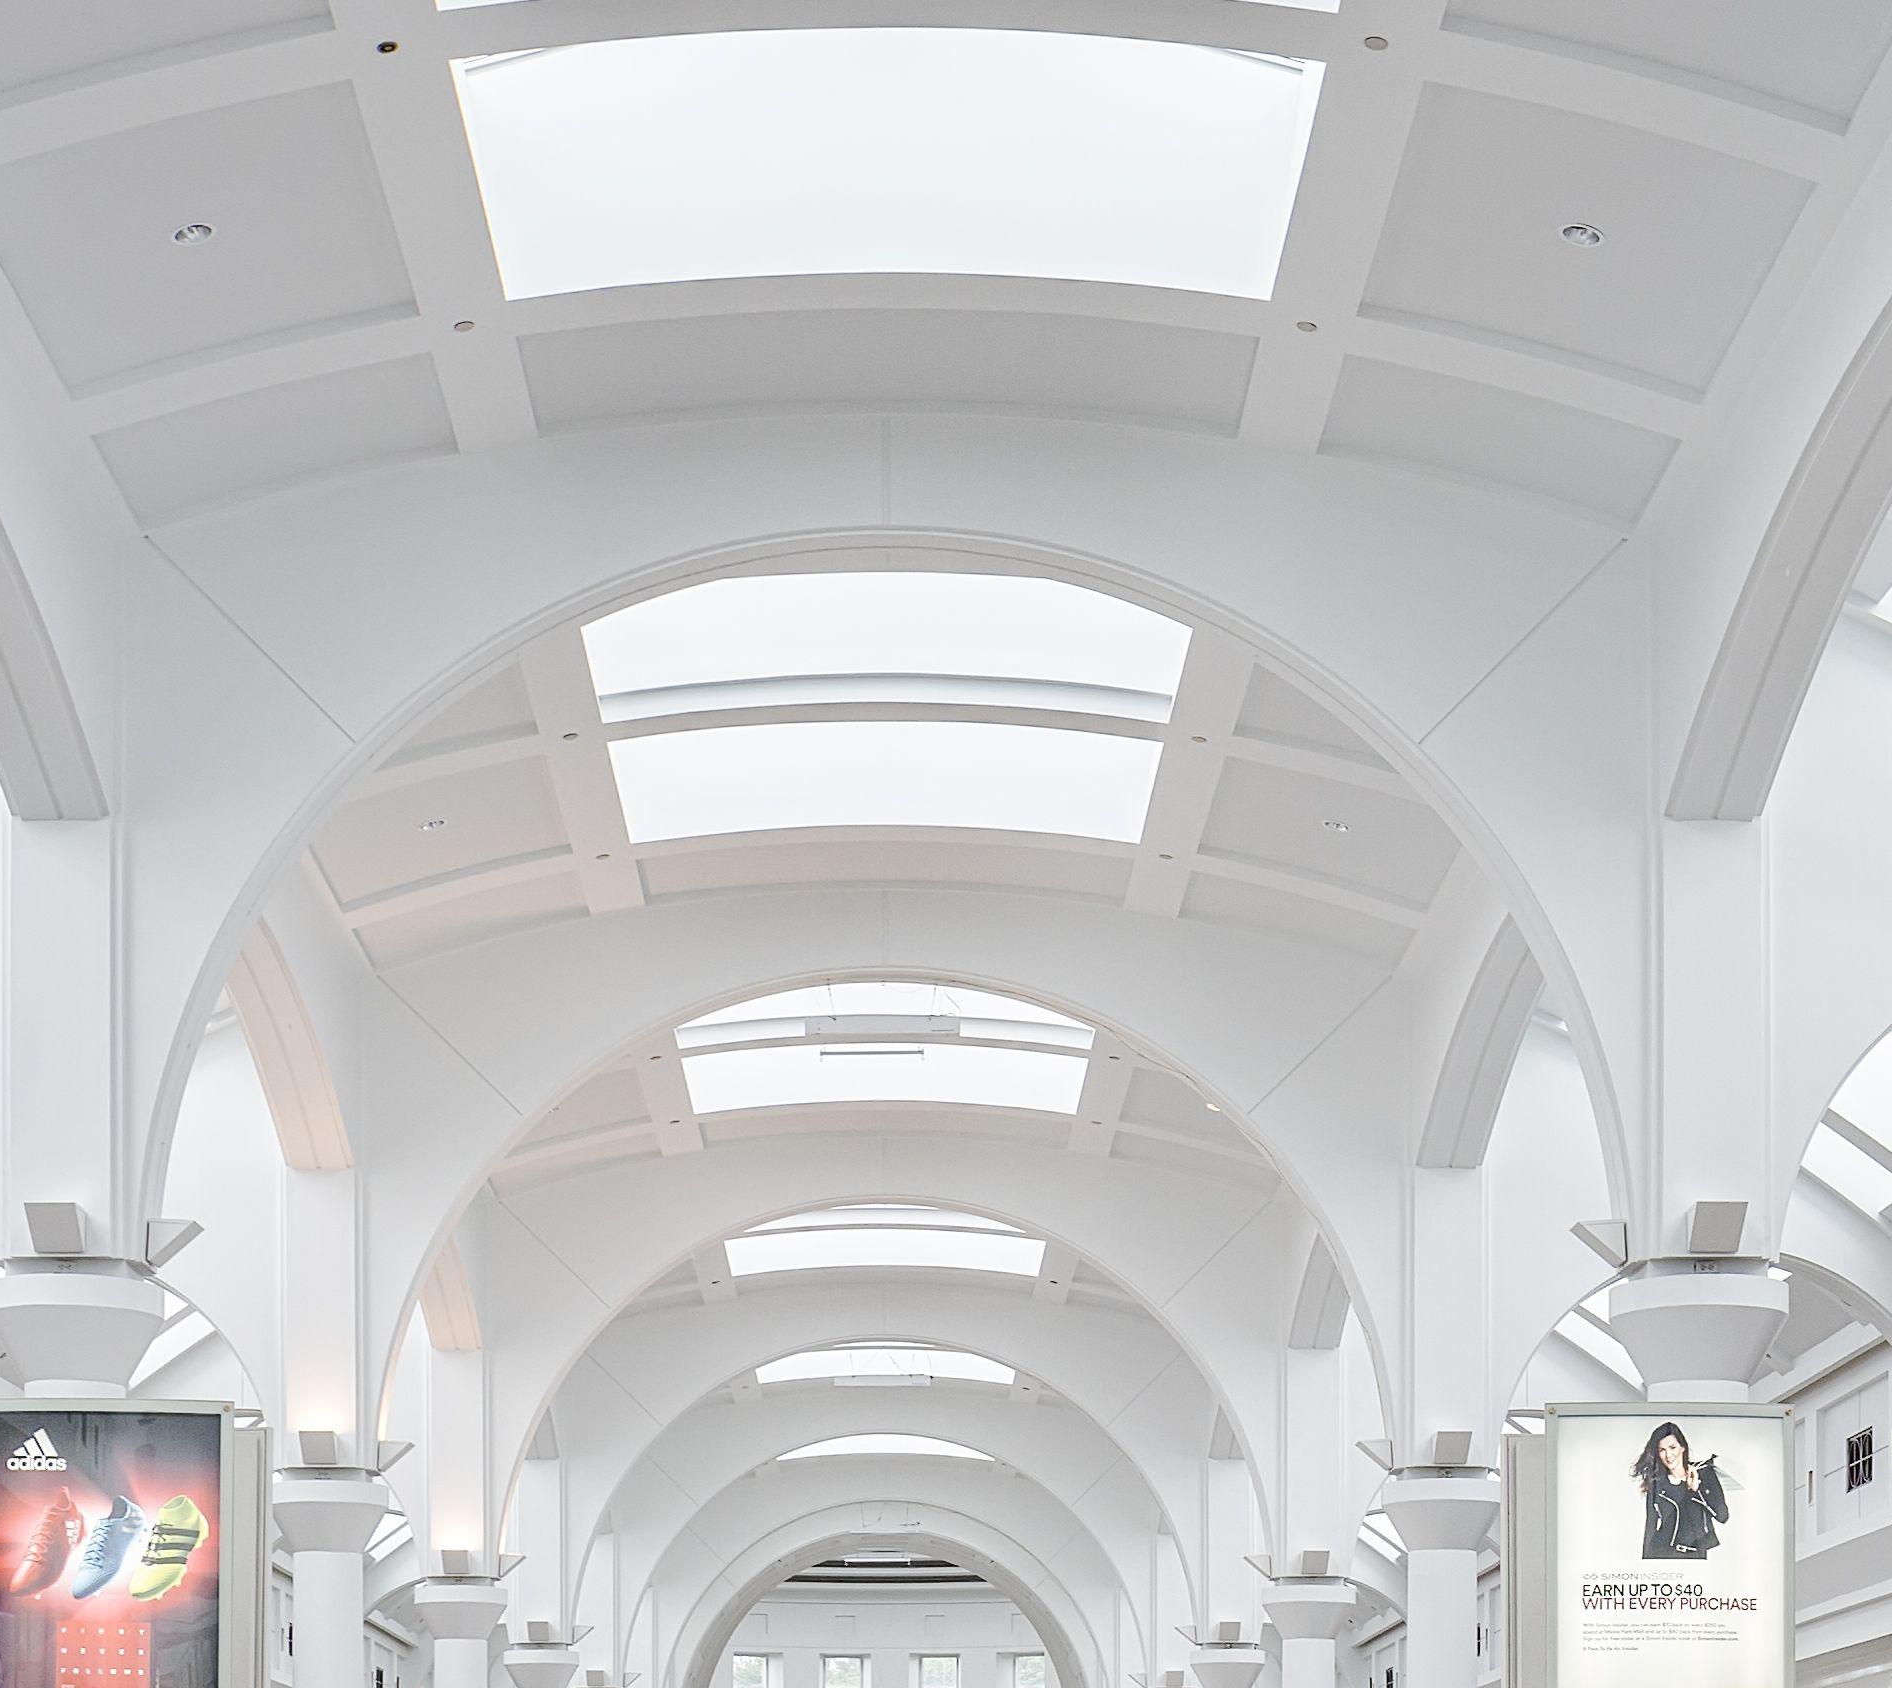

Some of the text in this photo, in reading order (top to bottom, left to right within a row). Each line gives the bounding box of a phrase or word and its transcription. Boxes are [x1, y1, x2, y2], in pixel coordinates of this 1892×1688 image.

[6, 1455, 67, 1471] adidas
[1582, 1584, 1703, 1597] EARN UP TO $40
[1582, 1598, 1758, 1611] WITH EVERY PURCHASE
